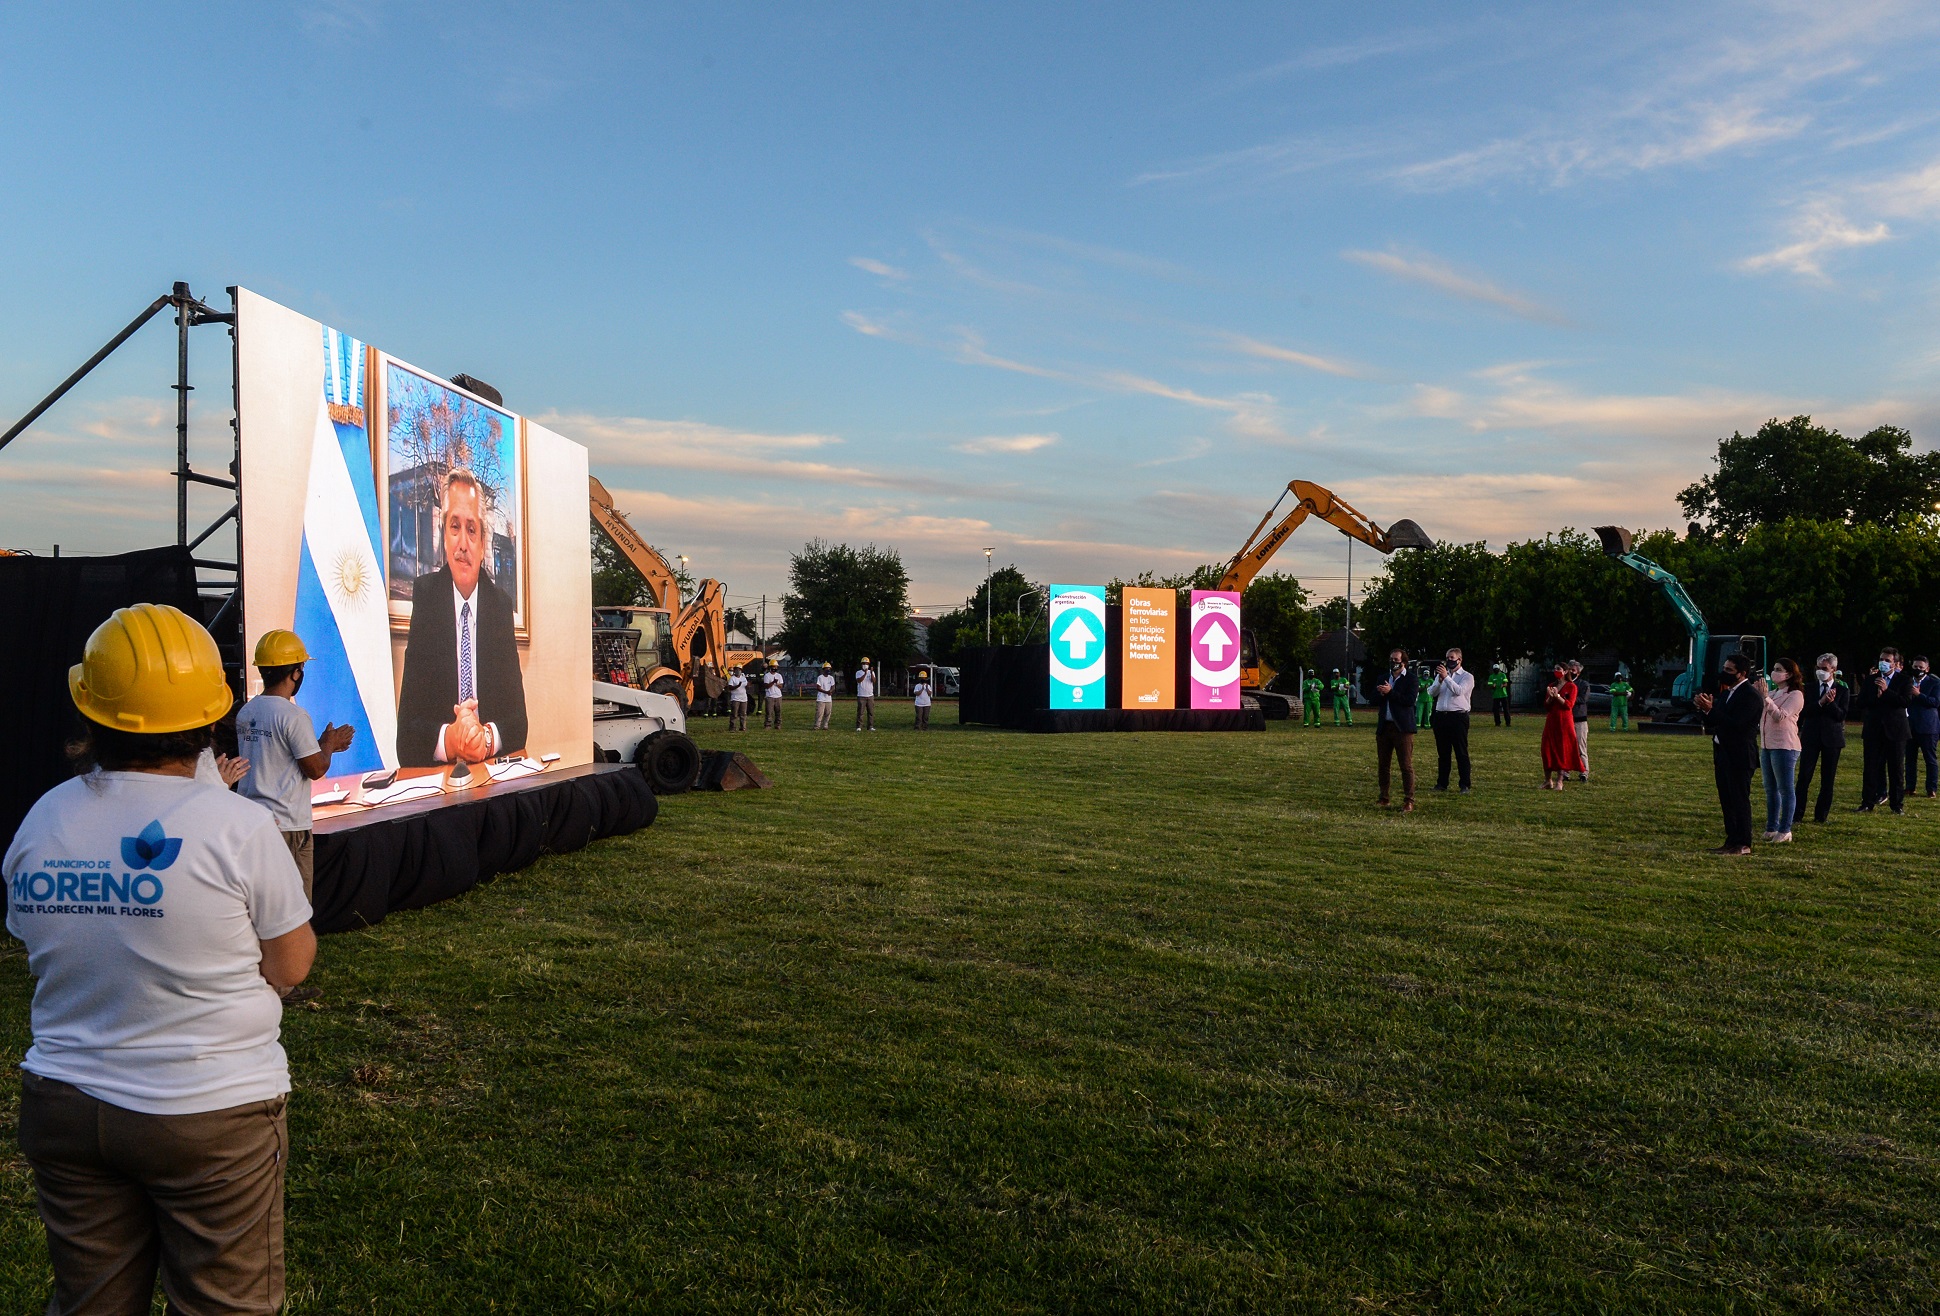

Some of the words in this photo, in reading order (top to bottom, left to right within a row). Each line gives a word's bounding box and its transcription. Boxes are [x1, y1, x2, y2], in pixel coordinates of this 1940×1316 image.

[605, 520, 637, 553] HYUNDAI
[1130, 598, 1151, 607] Obras
[1130, 607, 1168, 616] ferroviarias
[1140, 616, 1149, 624] los
[680, 616, 700, 650] HYUNDAI
[1130, 626, 1165, 634] municipios
[1140, 634, 1166, 643] Morón,
[1130, 643, 1150, 651] Merlo
[1152, 644, 1157, 652] y
[1130, 652, 1159, 660] Moreno.
[43, 860, 95, 869] MUNICIPIO
[98, 861, 111, 869] DE
[13, 872, 164, 905] MORENO
[14, 904, 34, 914] ONDE
[37, 905, 93, 914] FLORECEN
[97, 906, 117, 915] MIL
[120, 907, 164, 918] FLORES
